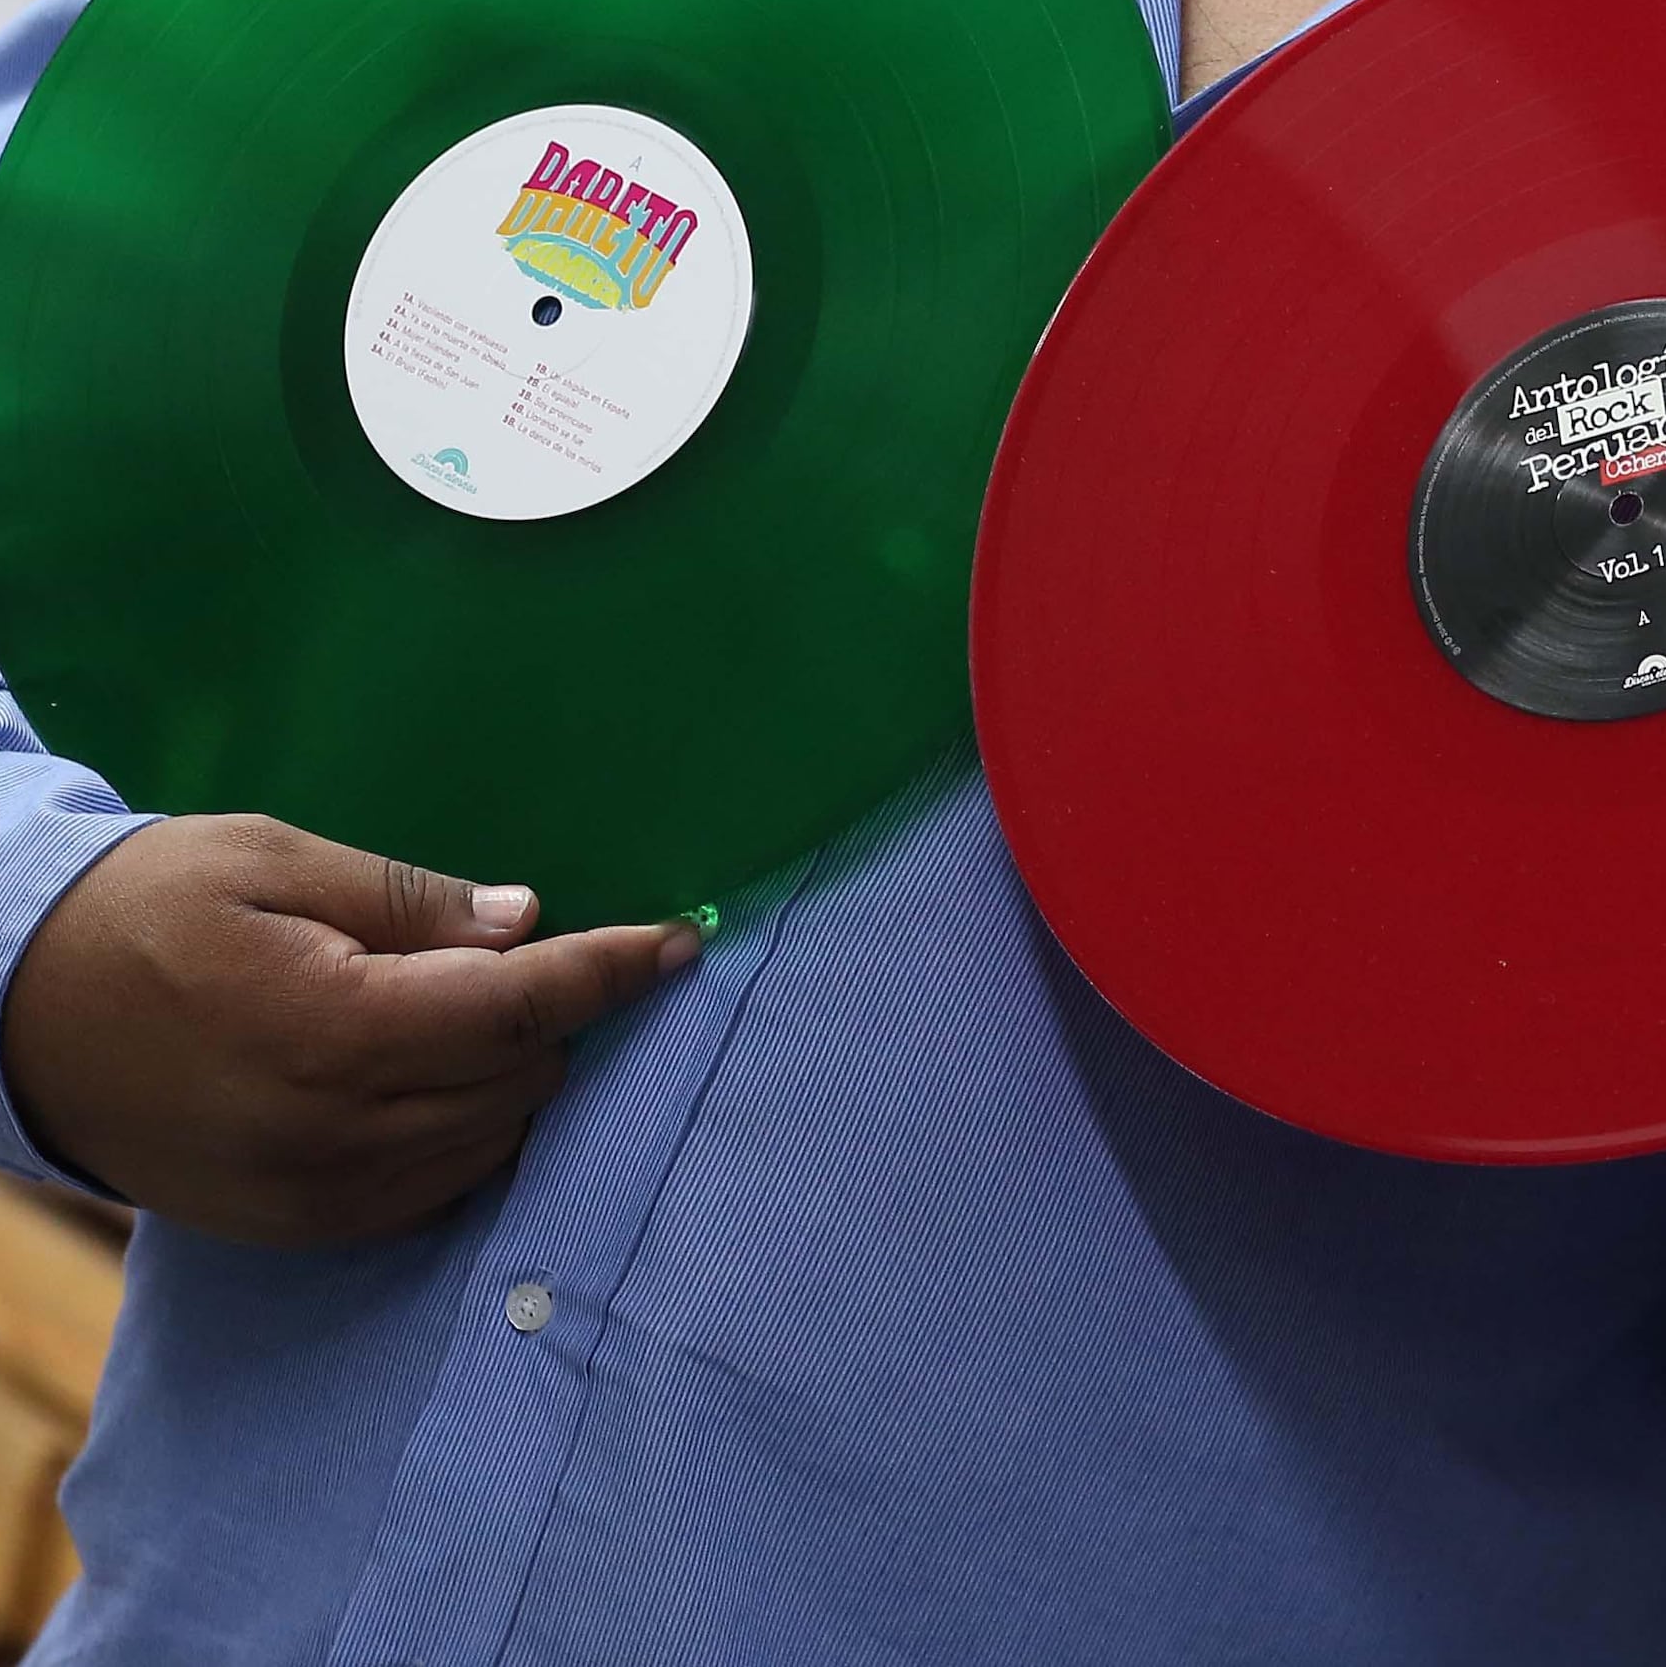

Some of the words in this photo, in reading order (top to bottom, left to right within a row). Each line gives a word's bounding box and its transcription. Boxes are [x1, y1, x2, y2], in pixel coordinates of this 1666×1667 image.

[1524, 422, 1559, 445] del
[1565, 390, 1656, 438] Rock
[1652, 544, 1665, 567] 1
[1638, 610, 1651, 626] A
